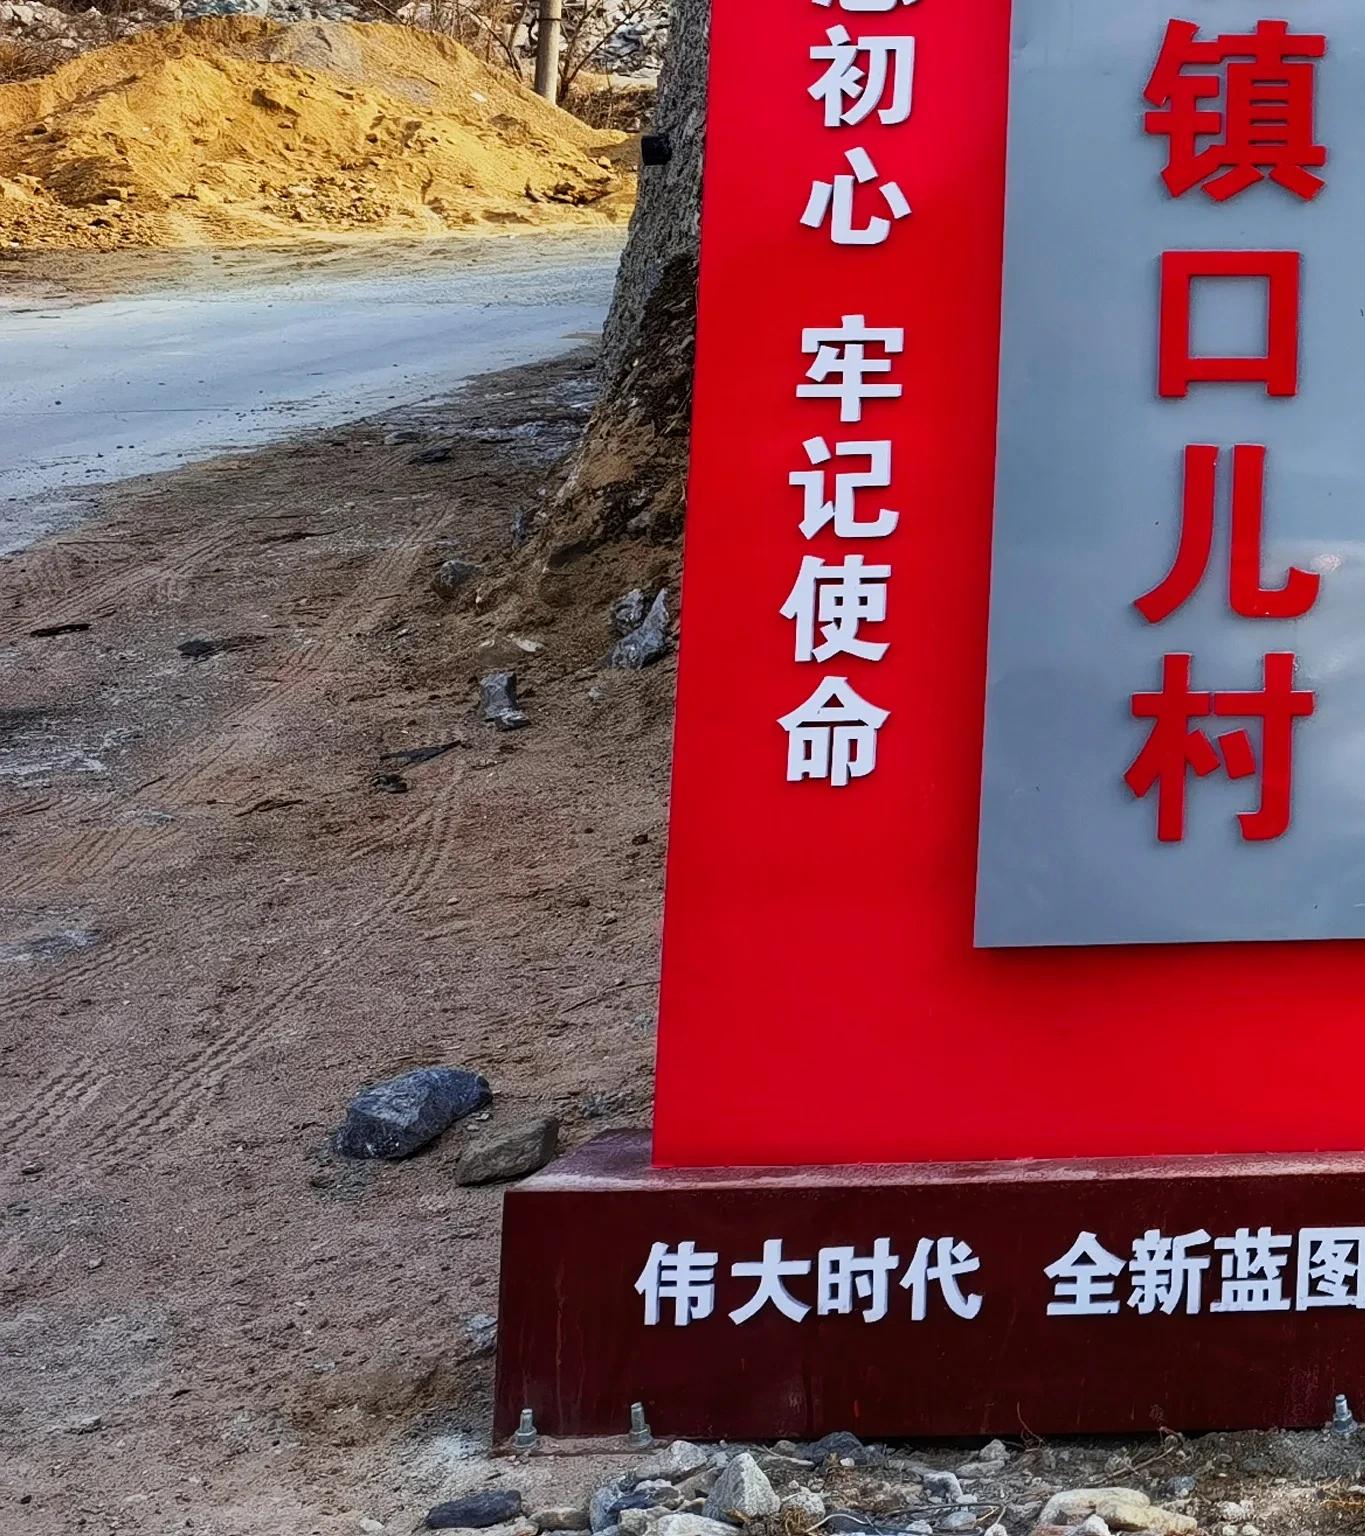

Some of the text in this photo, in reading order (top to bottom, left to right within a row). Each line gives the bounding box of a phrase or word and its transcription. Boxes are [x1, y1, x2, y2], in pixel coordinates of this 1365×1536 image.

[777, 313, 906, 789] 牢记使命
[634, 1237, 984, 1326] 伟大时代
